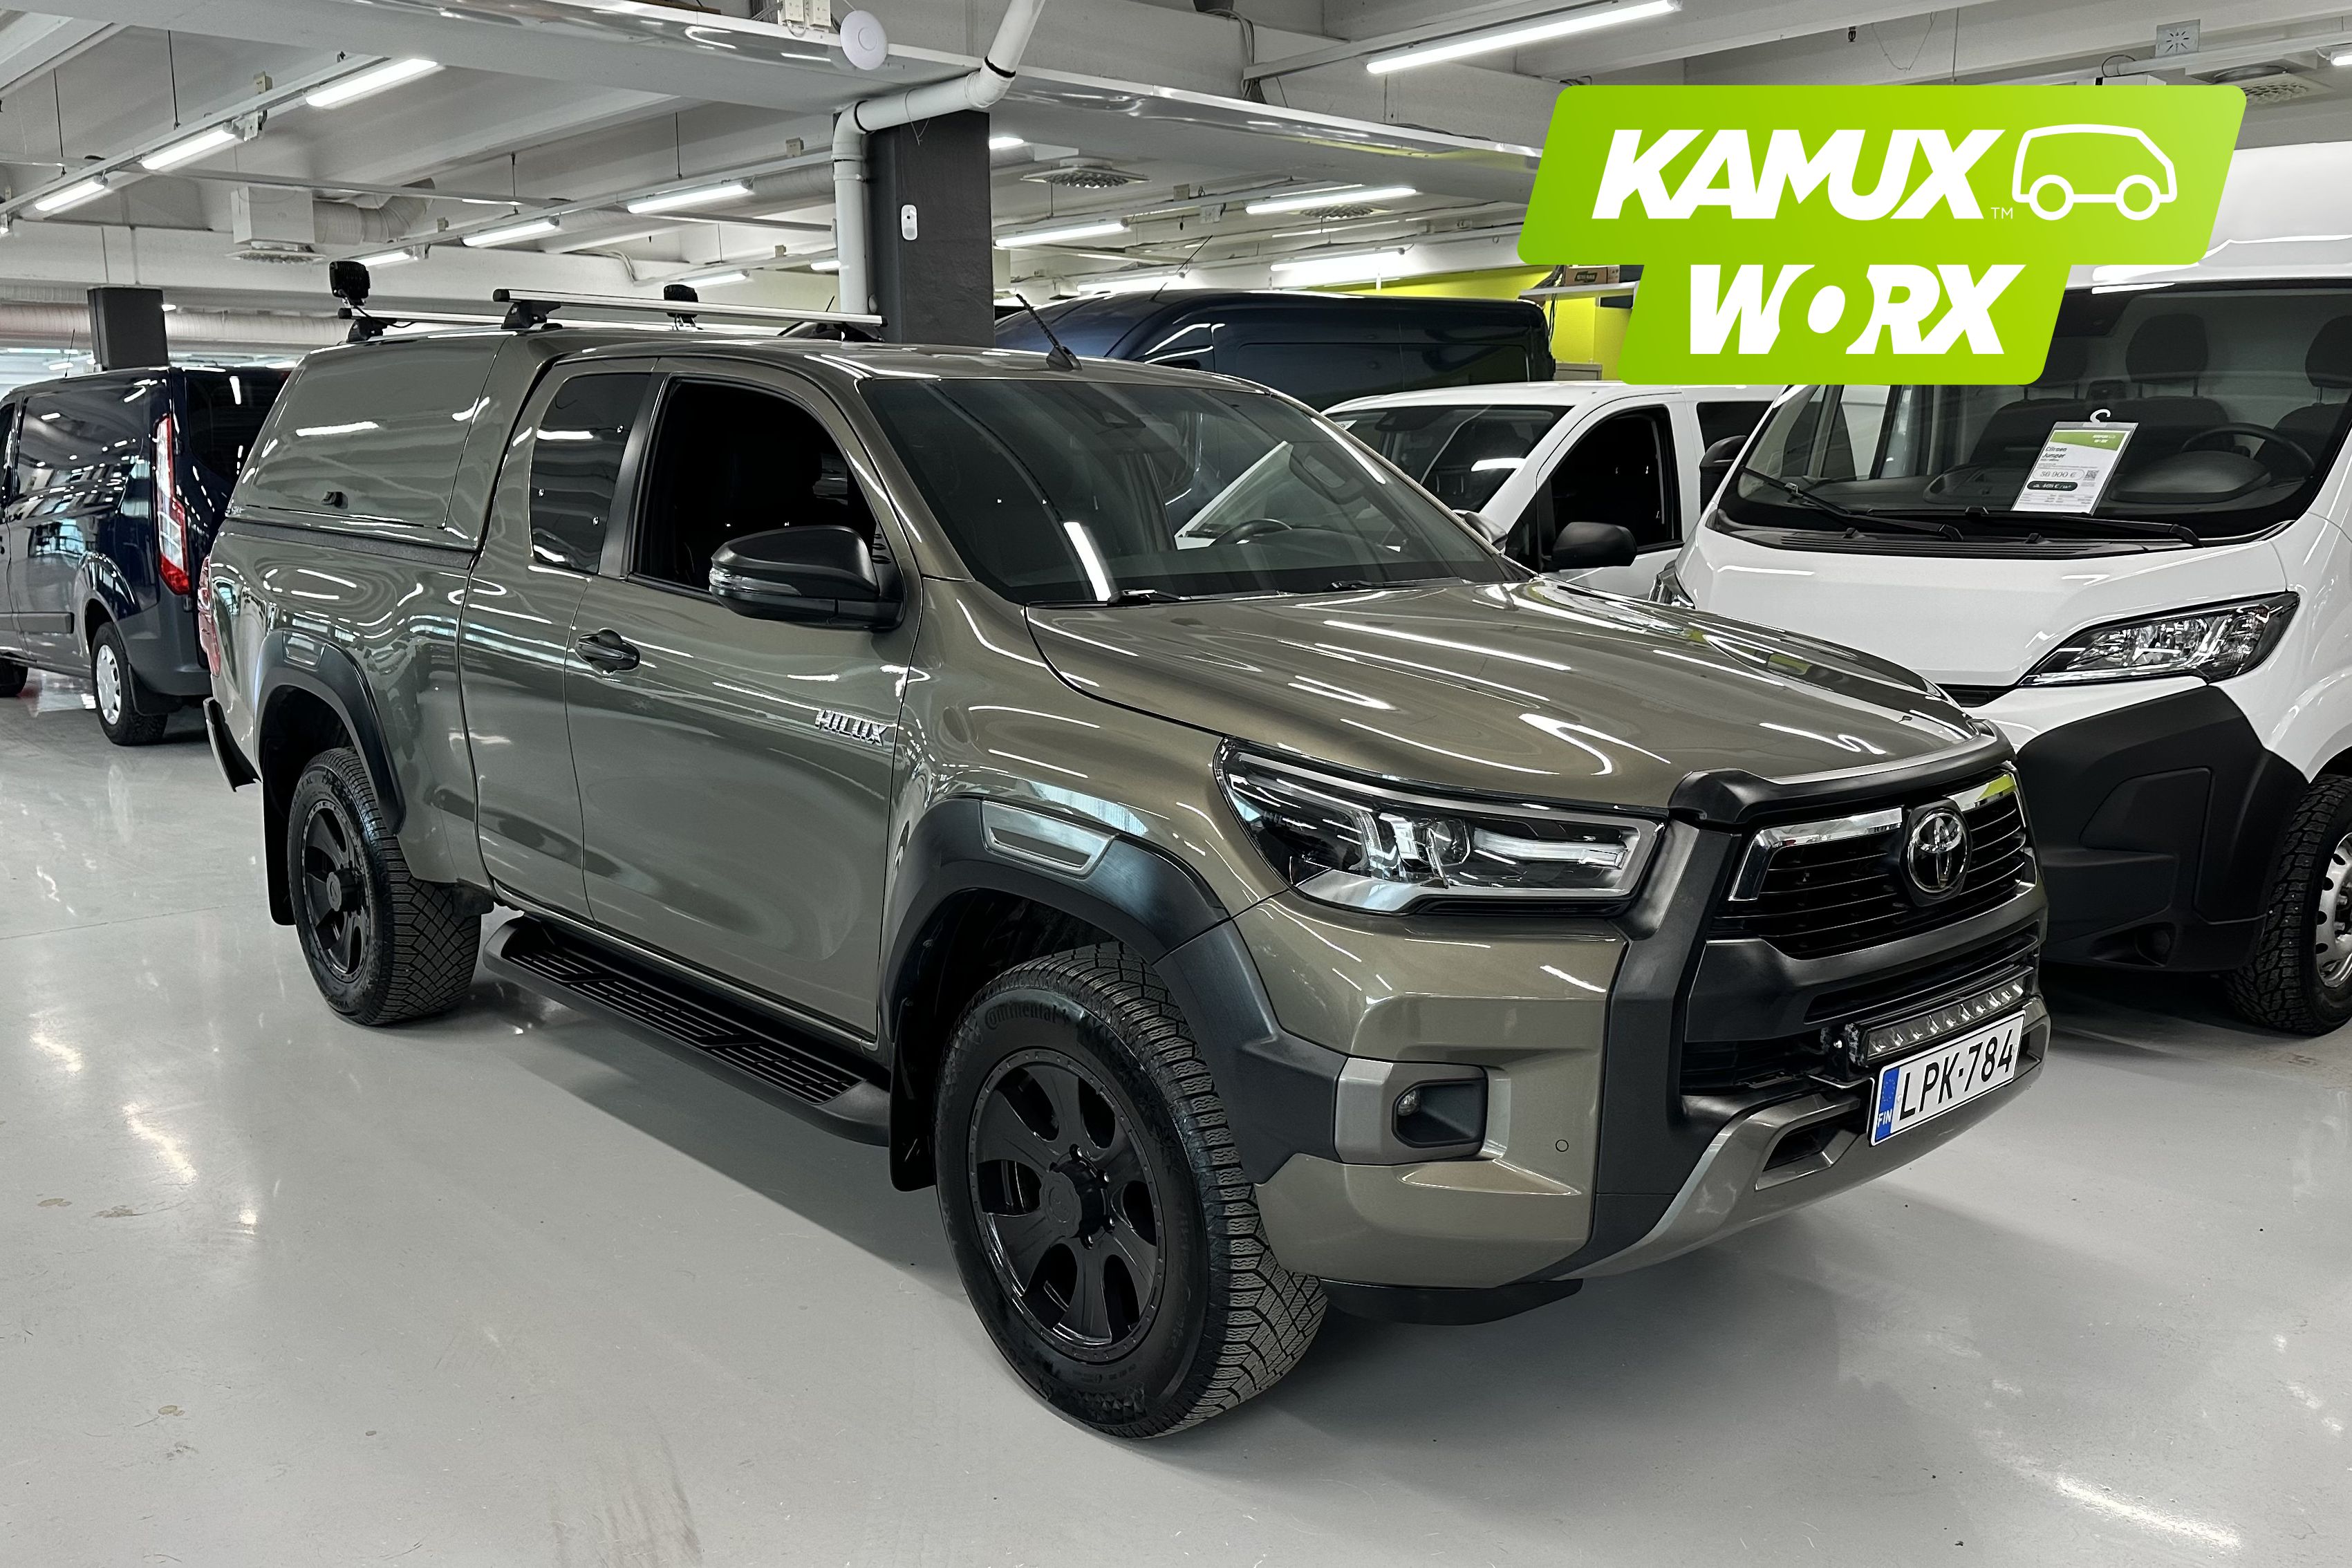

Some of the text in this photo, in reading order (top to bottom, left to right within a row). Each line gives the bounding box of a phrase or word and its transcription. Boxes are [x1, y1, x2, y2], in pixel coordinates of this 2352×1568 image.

[814, 709, 888, 747] HILUX
[985, 1000, 1057, 1030] Continental
[1898, 1028, 2013, 1121] LPK-784
[1877, 1108, 1893, 1128] FIN
